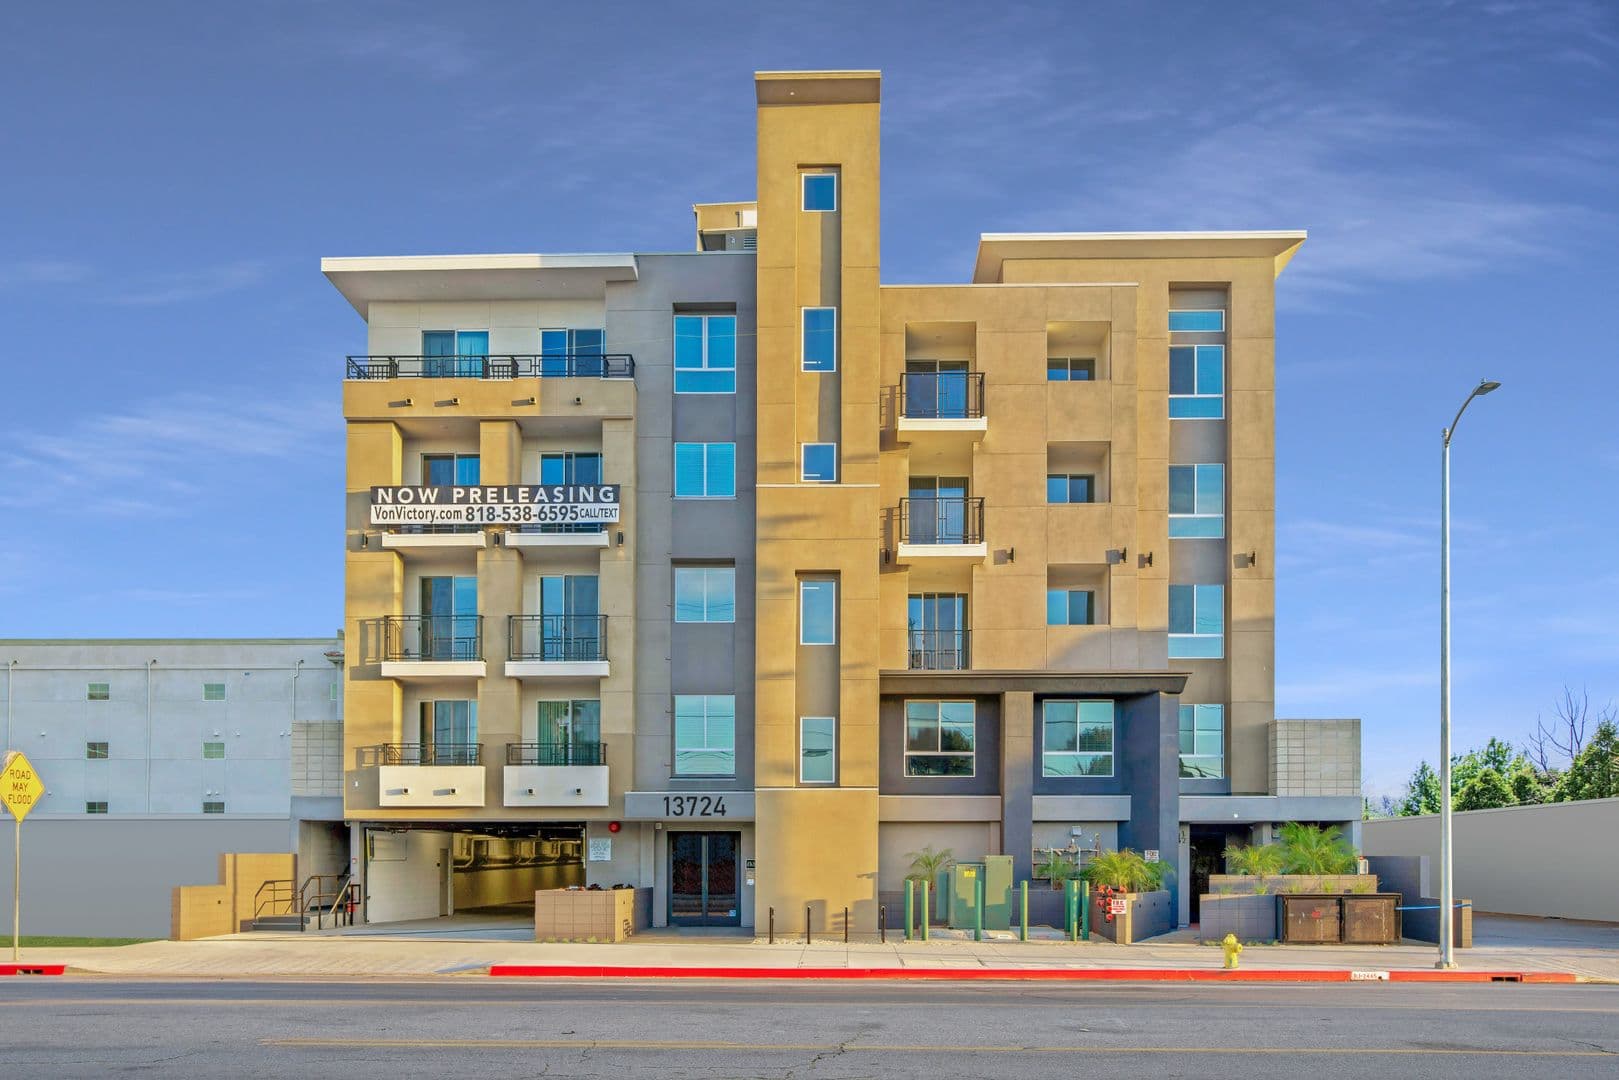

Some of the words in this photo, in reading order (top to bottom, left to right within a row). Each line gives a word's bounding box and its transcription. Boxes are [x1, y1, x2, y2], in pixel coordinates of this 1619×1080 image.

[377, 487, 438, 504] NOW
[452, 486, 615, 504] PRELEASING
[374, 506, 462, 523] VonVictory.com
[465, 506, 579, 522] 818-538-6595
[579, 508, 618, 519] CALL/TEXT
[9, 769, 31, 780] ROAD
[12, 782, 28, 792] MAY
[8, 794, 32, 805] FLOOD
[663, 796, 727, 816] 13724
